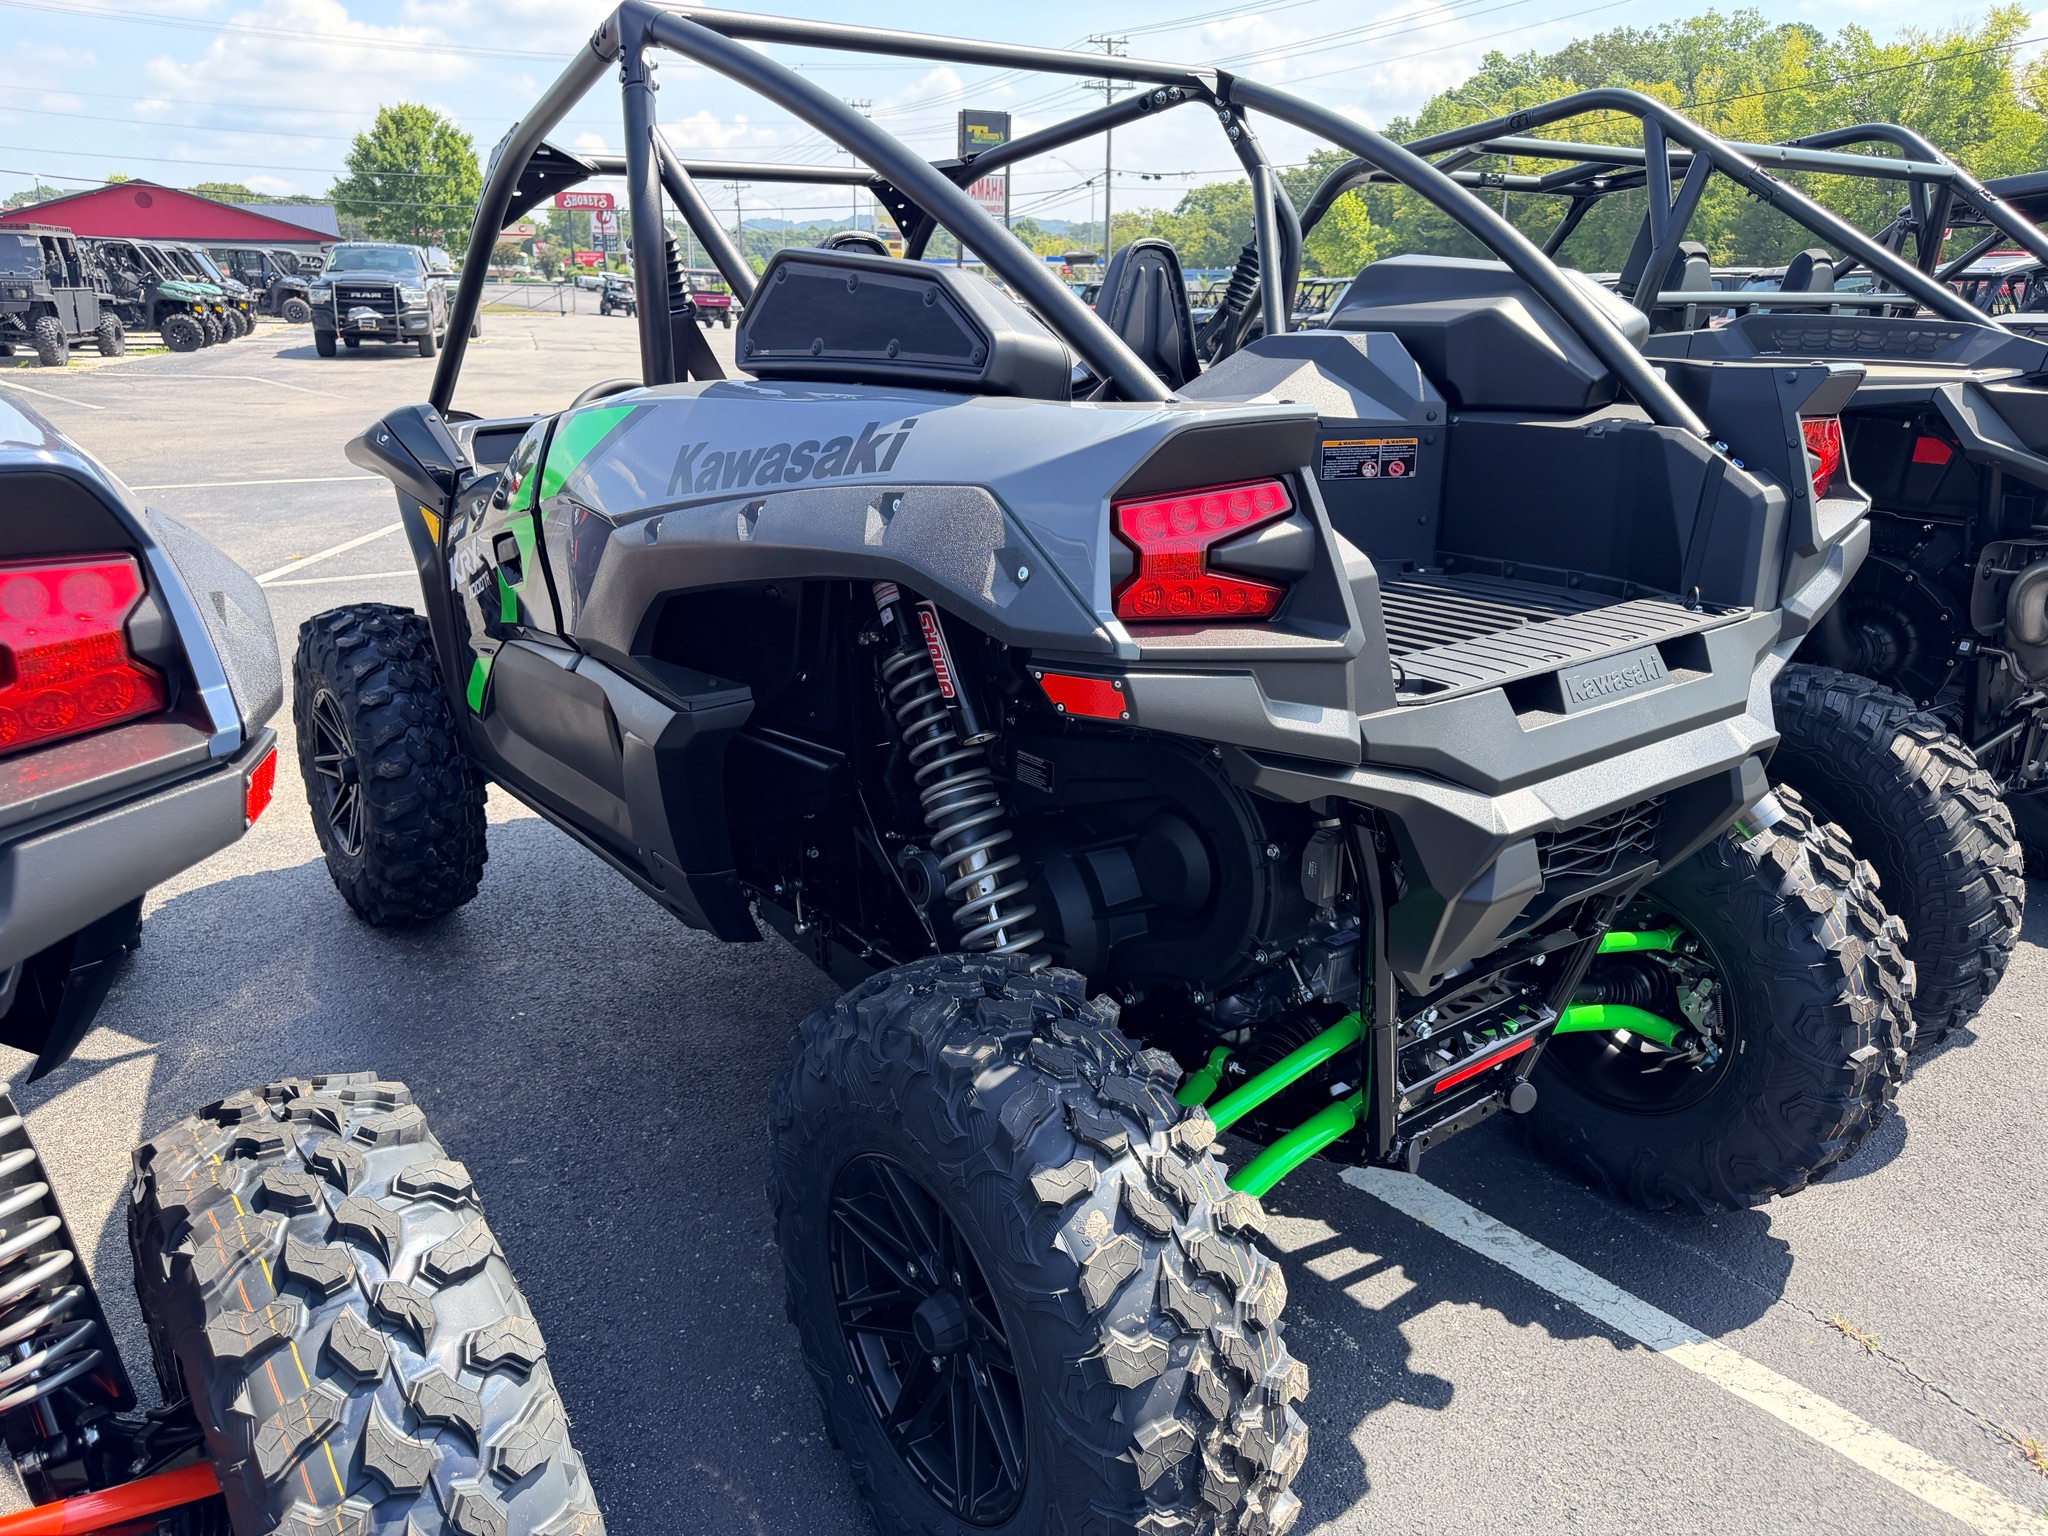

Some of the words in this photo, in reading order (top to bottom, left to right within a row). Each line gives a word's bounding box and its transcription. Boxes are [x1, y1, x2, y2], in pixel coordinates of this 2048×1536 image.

[563, 194, 608, 208] SHONEY'S
[666, 418, 919, 497] Kawasaki
[448, 535, 485, 591] KRX
[917, 611, 955, 699] SHOWA
[1564, 654, 1663, 704] Kawasaki
